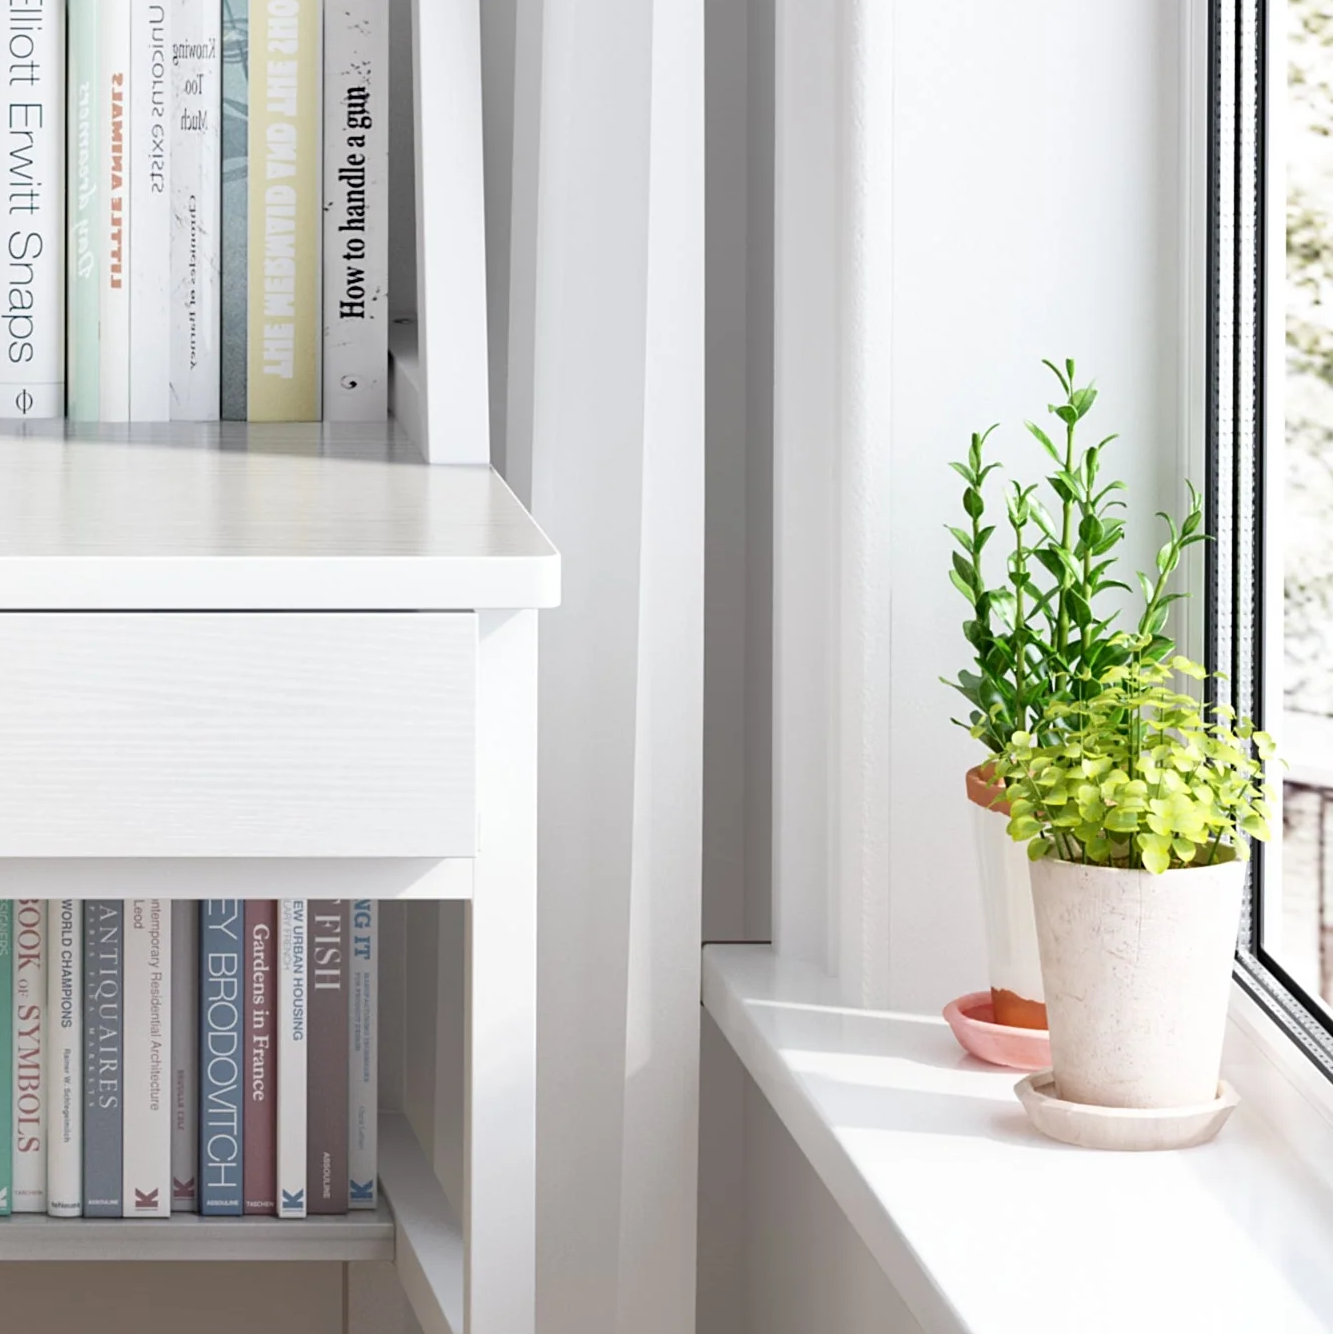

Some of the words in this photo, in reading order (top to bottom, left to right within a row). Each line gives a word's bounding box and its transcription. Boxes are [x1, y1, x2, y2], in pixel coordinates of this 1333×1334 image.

[347, 87, 371, 129] gun
[348, 135, 365, 147] a
[9, 104, 42, 214] Erwitt
[338, 154, 365, 231] handle
[343, 239, 365, 260] to
[1, 231, 42, 363] Snaps
[340, 267, 365, 318] How
[253, 924, 269, 1004] Gardens
[293, 926, 303, 973] URBAN
[315, 916, 341, 988] FISH
[95, 905, 119, 1110] ANTIQUAIRES
[151, 972, 162, 1036] Residential
[253, 1010, 269, 1028] in
[293, 978, 303, 1040] HOUSING
[18, 1005, 41, 1152] SYMBOLS
[150, 1040, 162, 1111] Architecture
[208, 953, 238, 1186] BRODOVITCH
[253, 1035, 268, 1101] France
